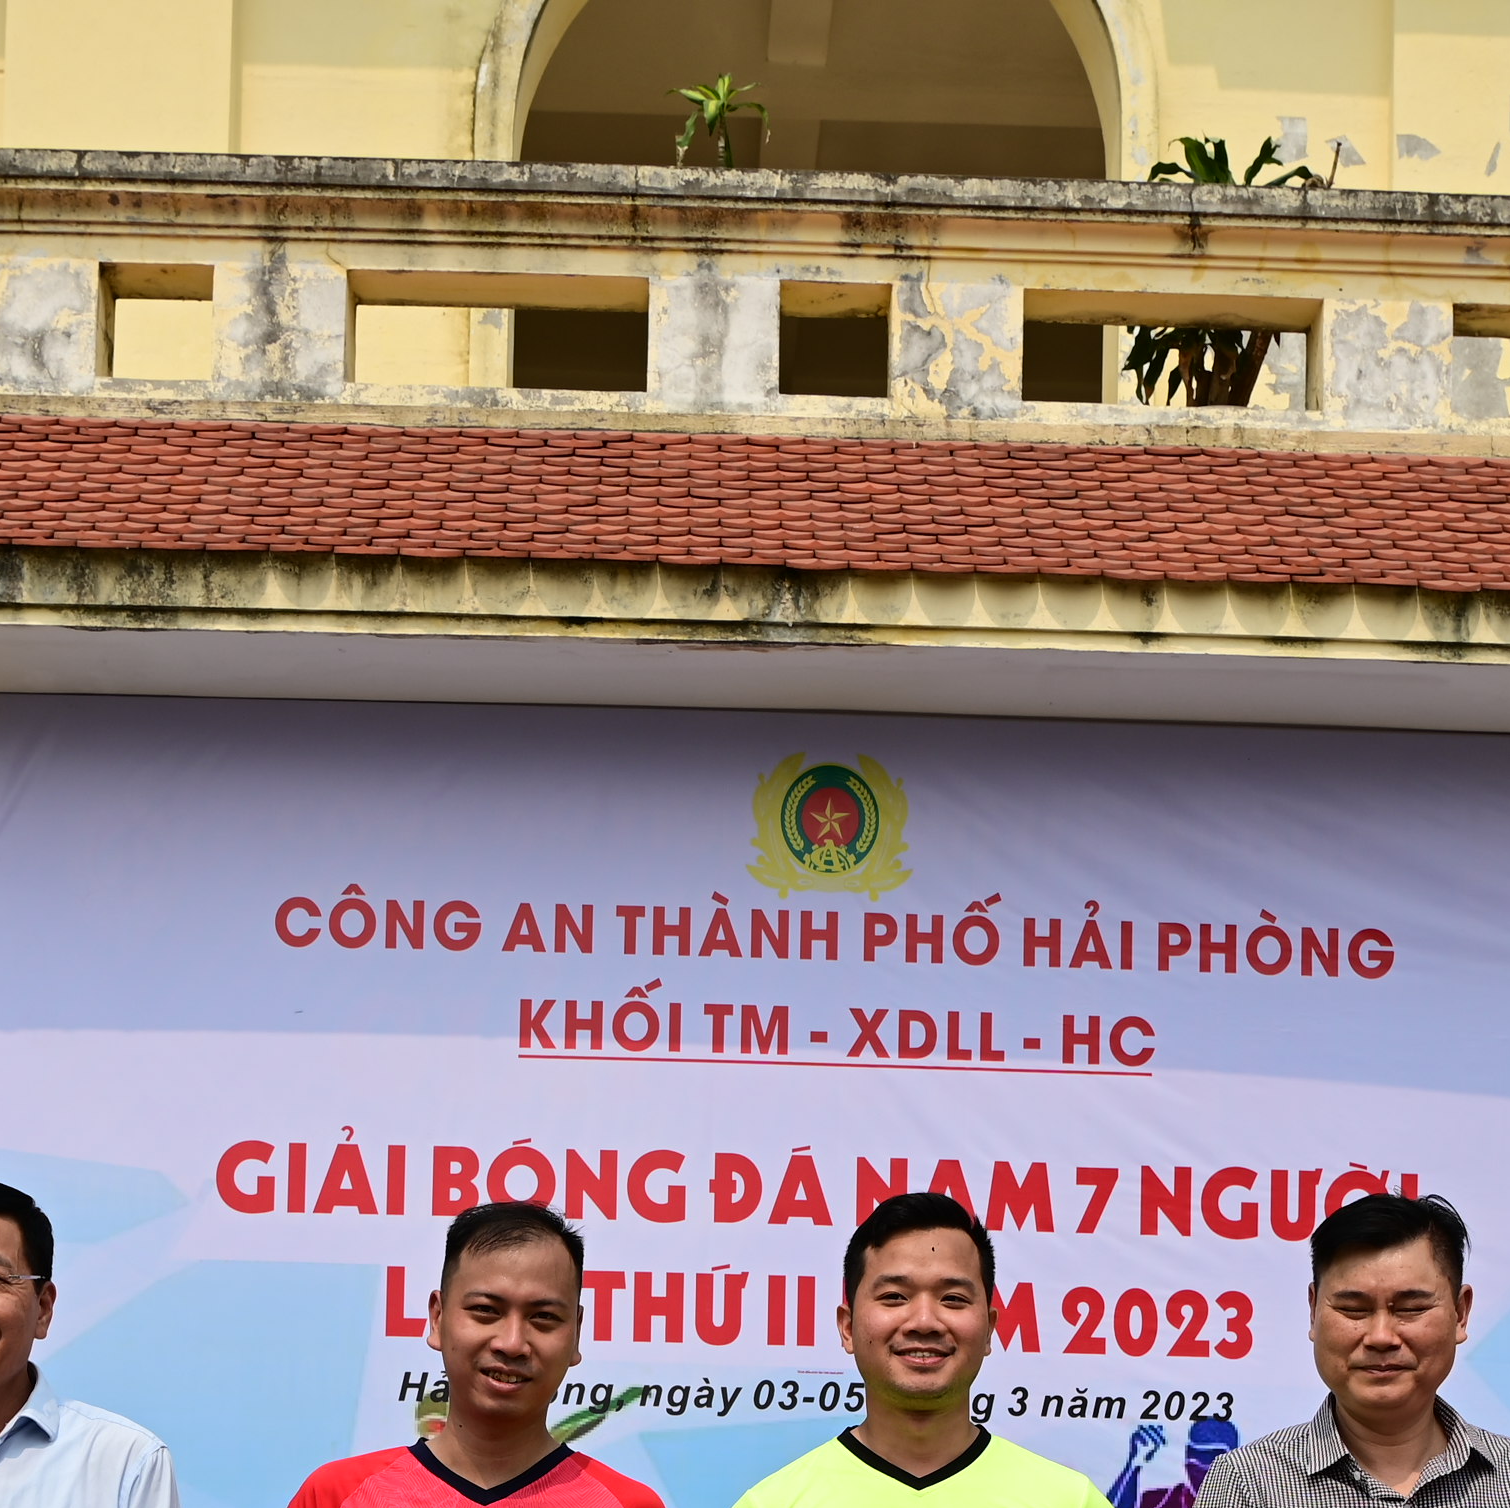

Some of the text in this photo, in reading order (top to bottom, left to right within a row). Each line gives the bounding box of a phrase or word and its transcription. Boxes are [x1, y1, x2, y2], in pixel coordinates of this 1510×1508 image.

[275, 883, 1395, 979] CÔNG AN THÀNH PHỐ HẢI PHÒNG
[519, 978, 681, 1052] KHỐI
[704, 1004, 789, 1055] TM
[847, 1008, 1005, 1062] XDLL
[1061, 1014, 1155, 1066] HC
[215, 1125, 407, 1216] GIẢI
[432, 1138, 686, 1224] BÓNG
[709, 1146, 834, 1226] ĐÁ
[1075, 1166, 1119, 1234] 7
[582, 1264, 749, 1346] THỨ
[767, 1275, 815, 1346] II
[1063, 1287, 1253, 1360] 2023
[399, 1371, 449, 1402] Hả
[639, 1378, 743, 1416] ngày
[753, 1380, 865, 1412] 03-05
[1008, 1386, 1029, 1416] 3
[1041, 1388, 1127, 1419] năm
[1140, 1390, 1234, 1422] 2023
